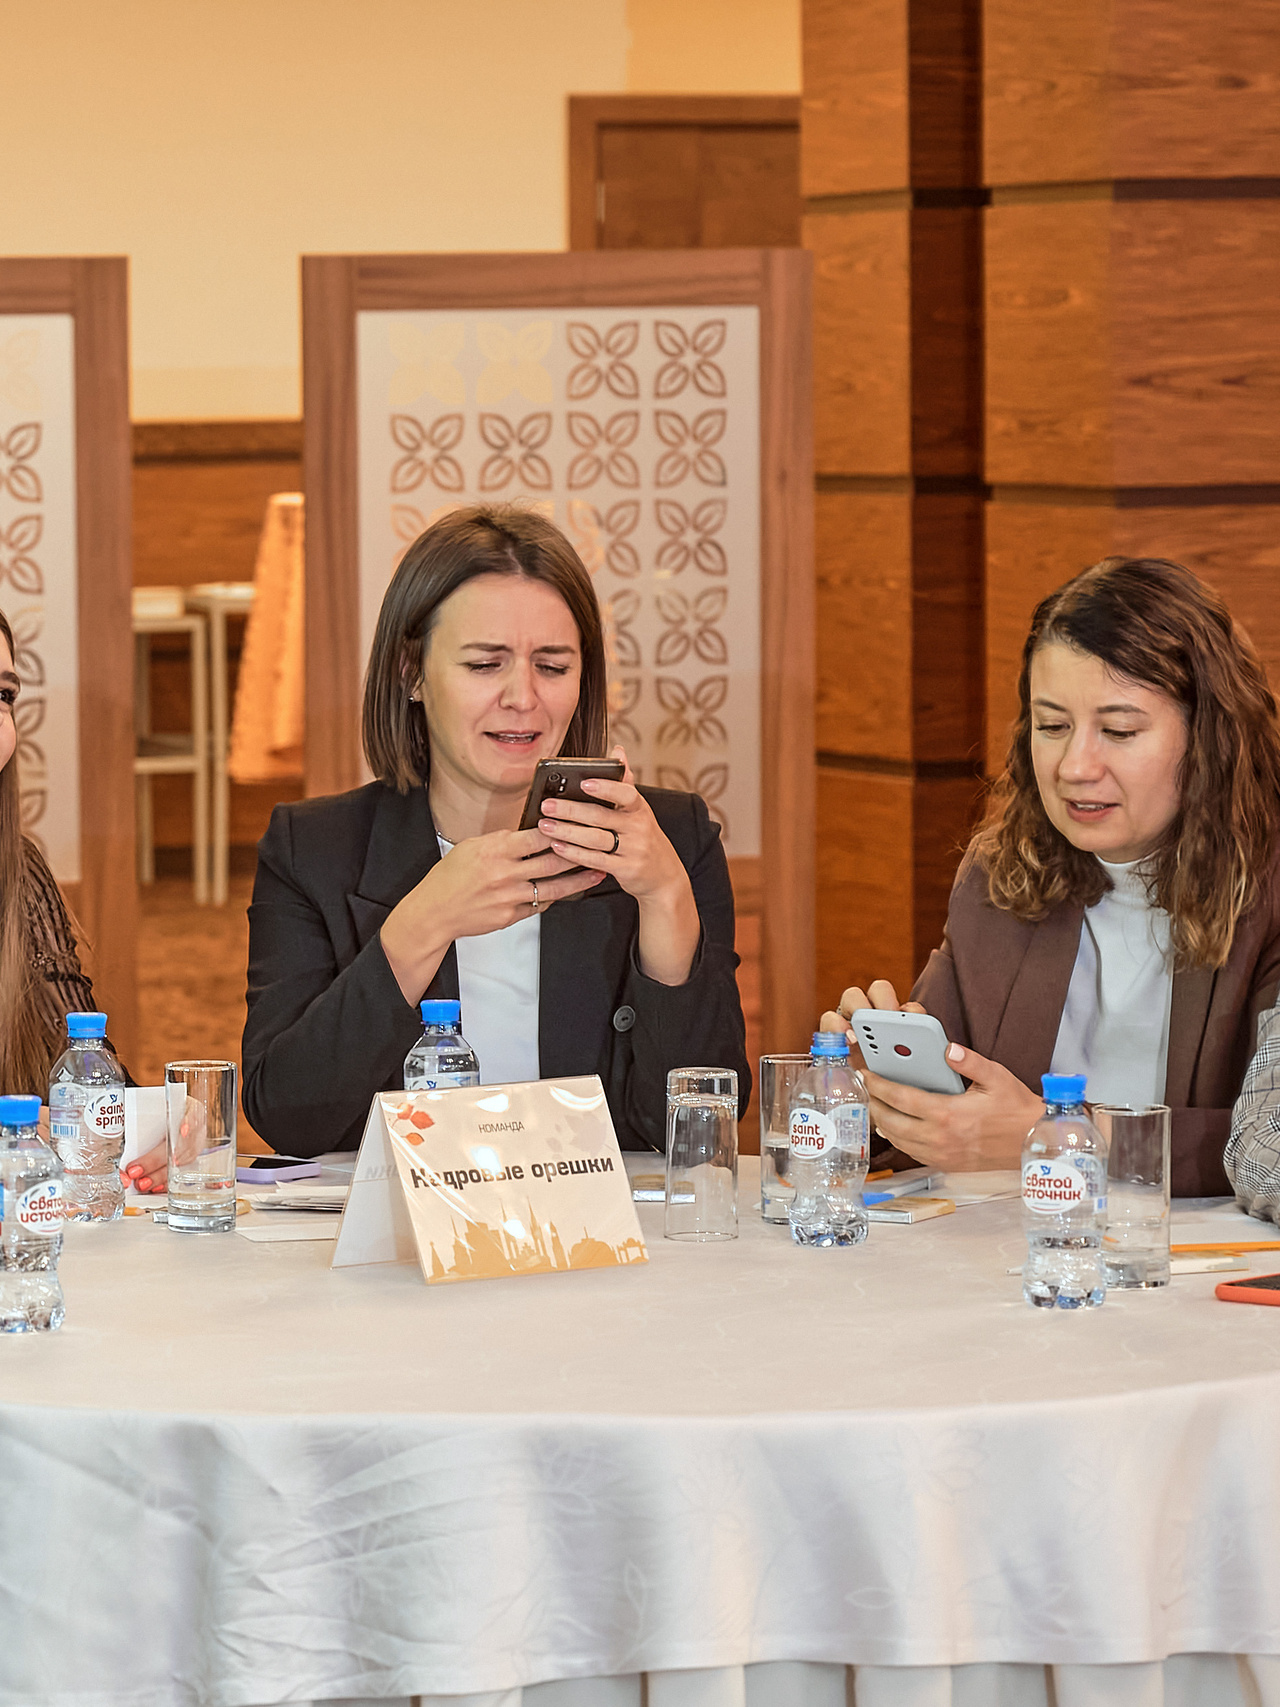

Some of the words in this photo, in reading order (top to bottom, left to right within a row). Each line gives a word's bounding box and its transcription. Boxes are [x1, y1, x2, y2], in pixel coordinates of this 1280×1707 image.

[478, 1121, 525, 1133] КОМАНДА
[792, 1123, 820, 1135] saint
[791, 1134, 825, 1150] spring
[531, 1157, 614, 1183] орешки
